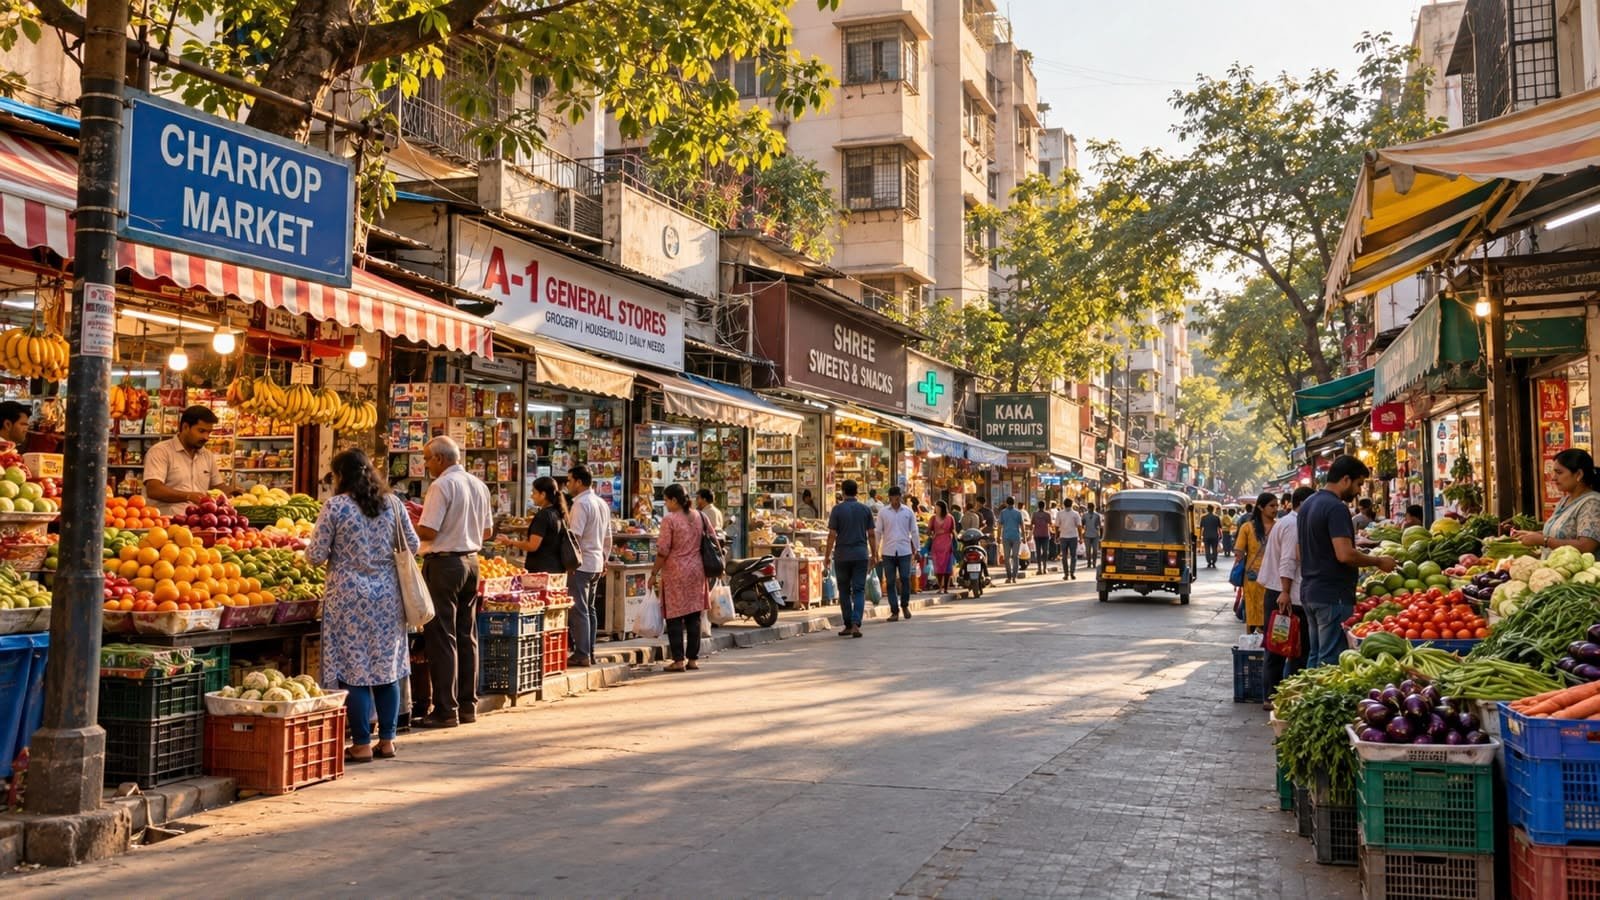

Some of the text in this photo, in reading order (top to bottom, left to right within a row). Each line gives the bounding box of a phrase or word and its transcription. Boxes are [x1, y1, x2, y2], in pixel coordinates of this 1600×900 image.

[160, 123, 322, 204] CHARKOP
[182, 186, 314, 256] MARKET
[482, 246, 667, 337] A-1 GENERAL STORES
[545, 311, 579, 331] GROCERY
[585, 322, 624, 342] HOUSEHOLD
[629, 334, 646, 349] DAILY
[646, 338, 665, 354] NEEDS
[834, 323, 876, 363] SHREE
[809, 348, 893, 394] SWEETS & SNACKS
[986, 423, 1044, 436] DRY FRUITS
[995, 404, 1034, 420] KAKA
